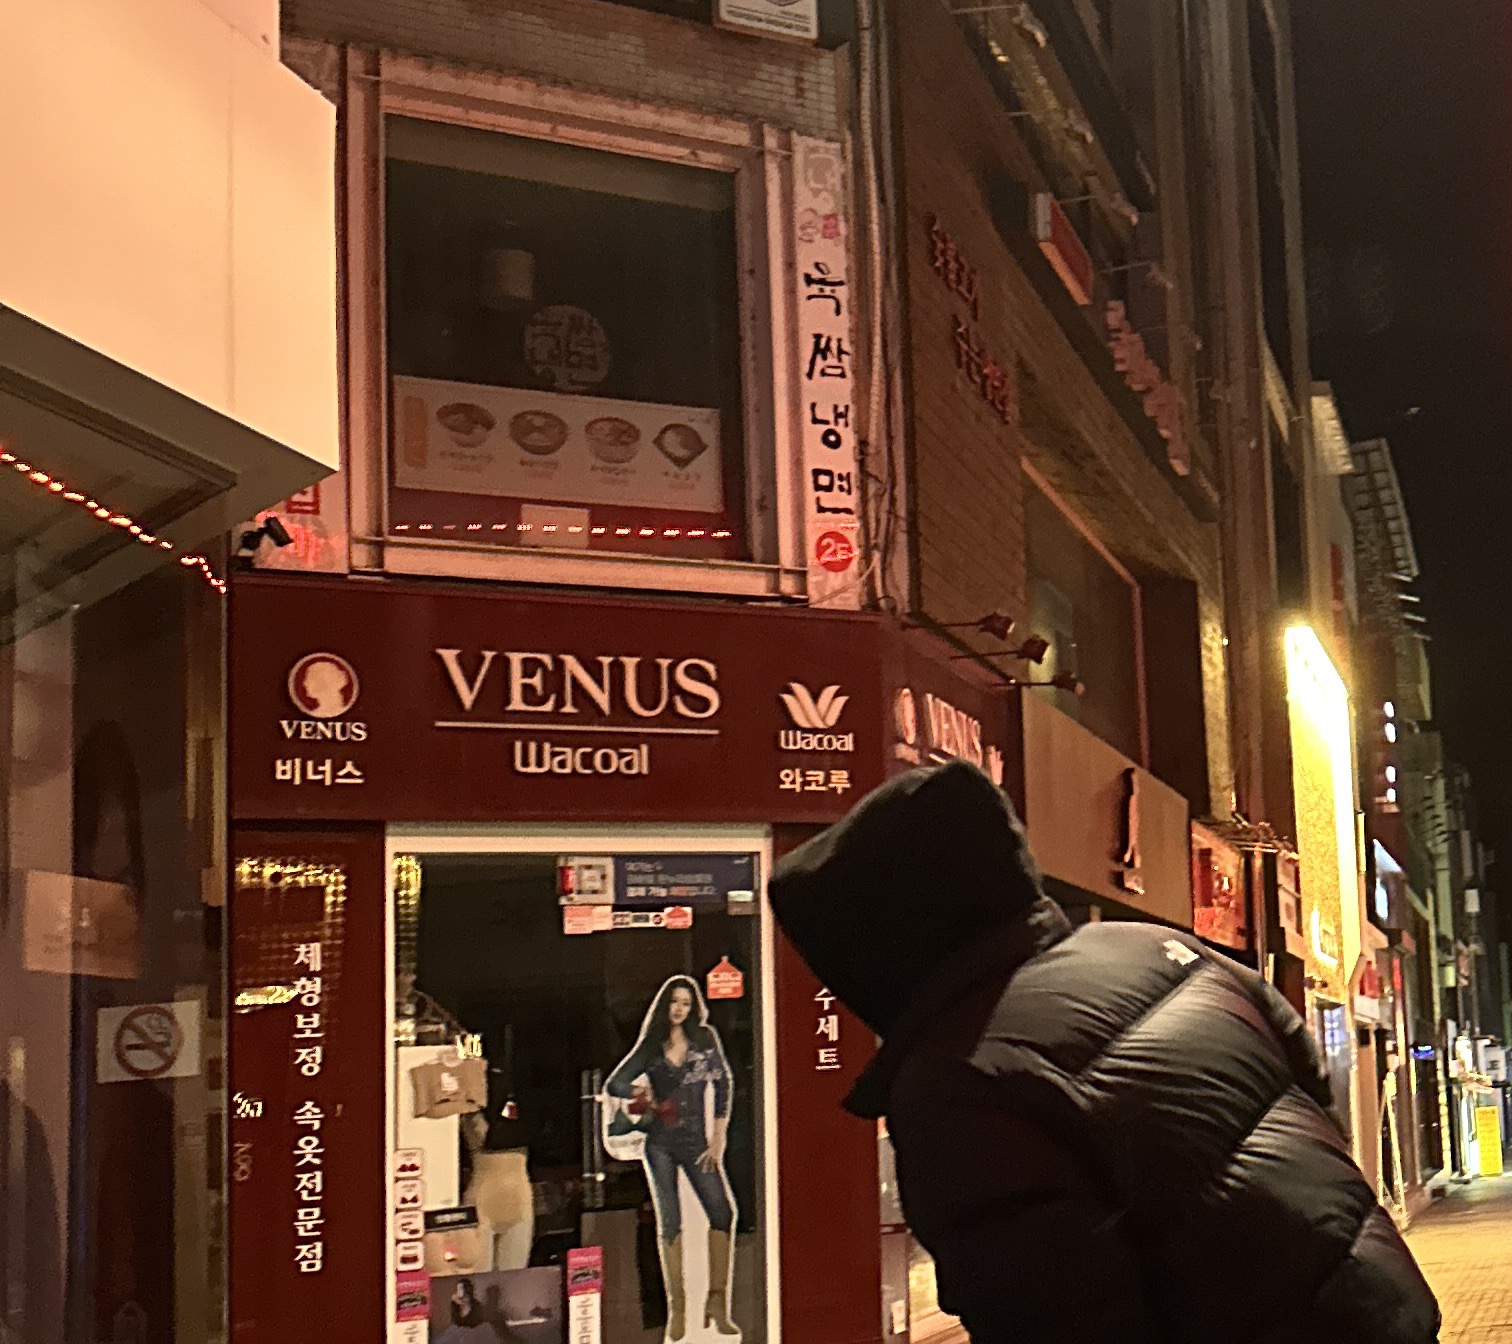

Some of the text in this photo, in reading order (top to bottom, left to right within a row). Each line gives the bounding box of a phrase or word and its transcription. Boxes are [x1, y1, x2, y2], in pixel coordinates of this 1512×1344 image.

[803, 261, 855, 516] 육쌈냉면
[435, 648, 720, 718] VENUS
[280, 718, 368, 742] VENUS
[779, 729, 854, 752] Wacoal
[275, 758, 365, 786] 비너스
[514, 740, 650, 775] Wacoal
[779, 768, 852, 794] 와코루
[293, 941, 325, 1273] 체형보정 속옷전문점
